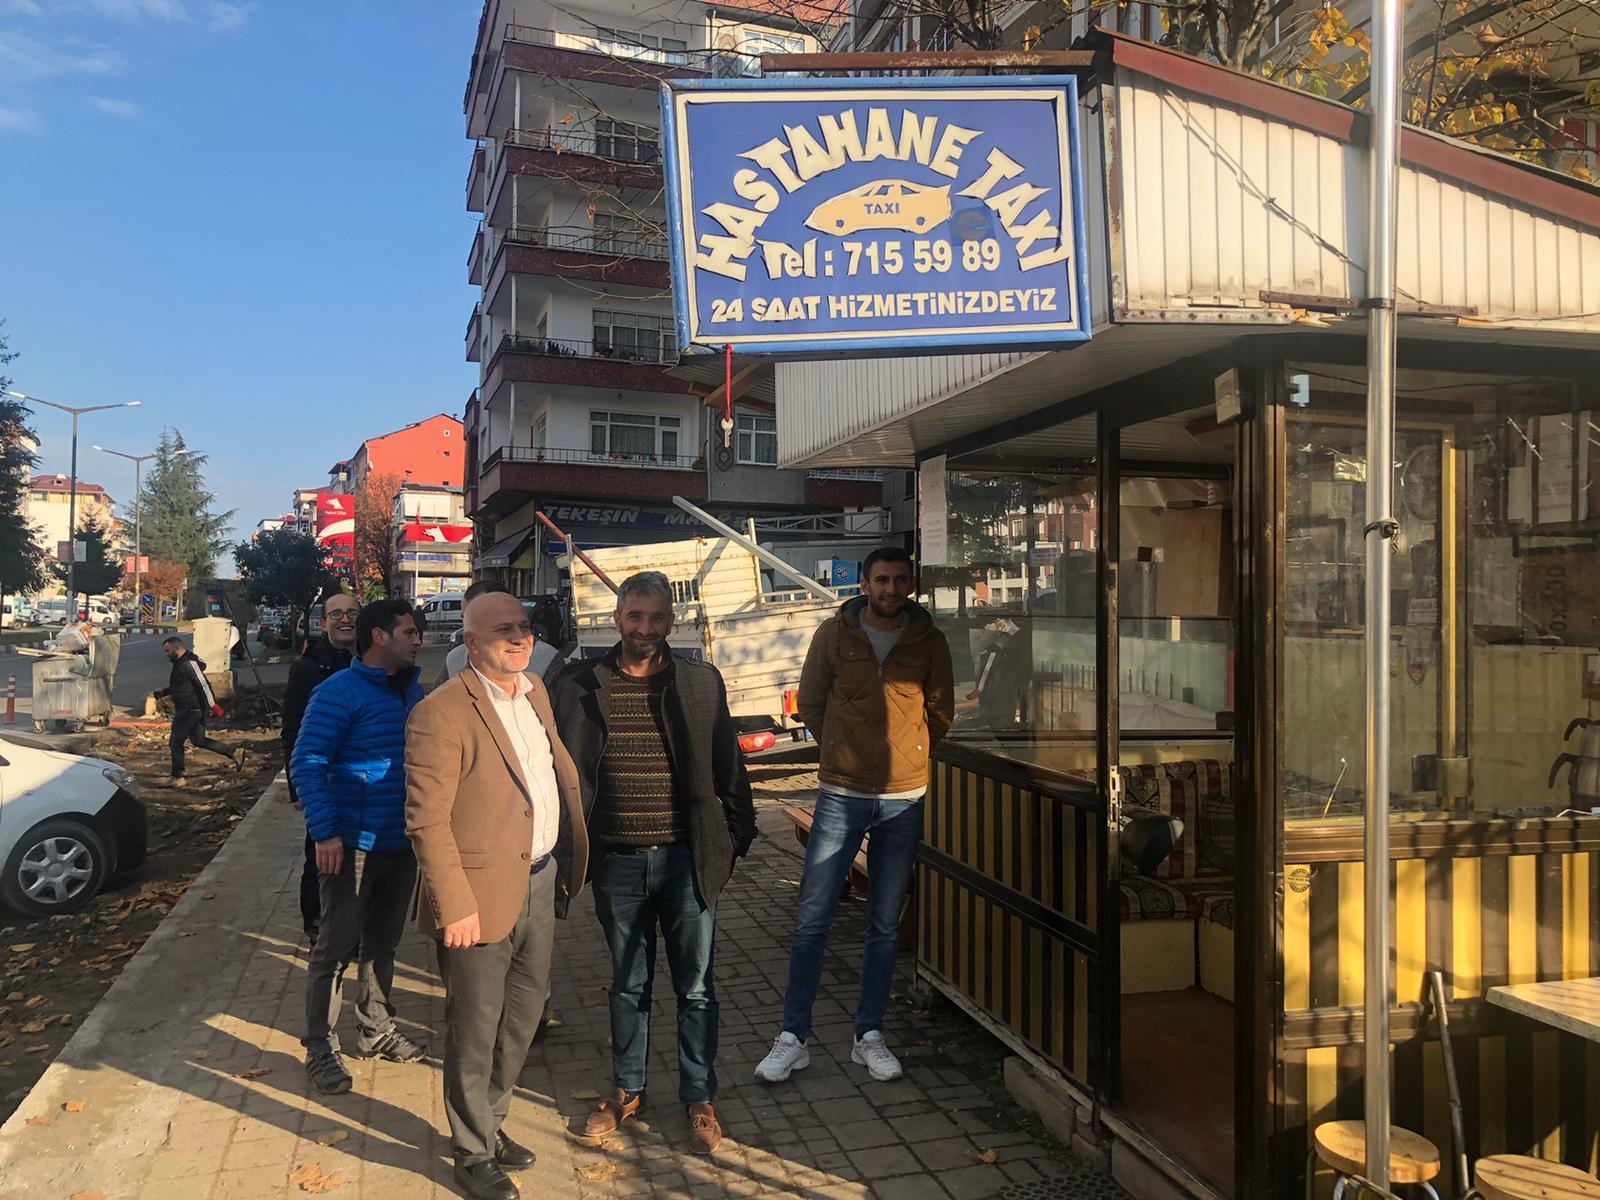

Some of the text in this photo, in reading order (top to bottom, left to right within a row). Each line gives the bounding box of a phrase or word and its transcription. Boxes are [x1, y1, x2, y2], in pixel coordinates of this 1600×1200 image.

[697, 107, 1069, 281] HASTAHANE TAXI
[864, 203, 900, 215] TAXI
[842, 240, 903, 276] 715
[914, 239, 952, 273] 59
[962, 238, 1001, 272] 89
[710, 298, 744, 323] 24
[751, 295, 821, 322] SAAT
